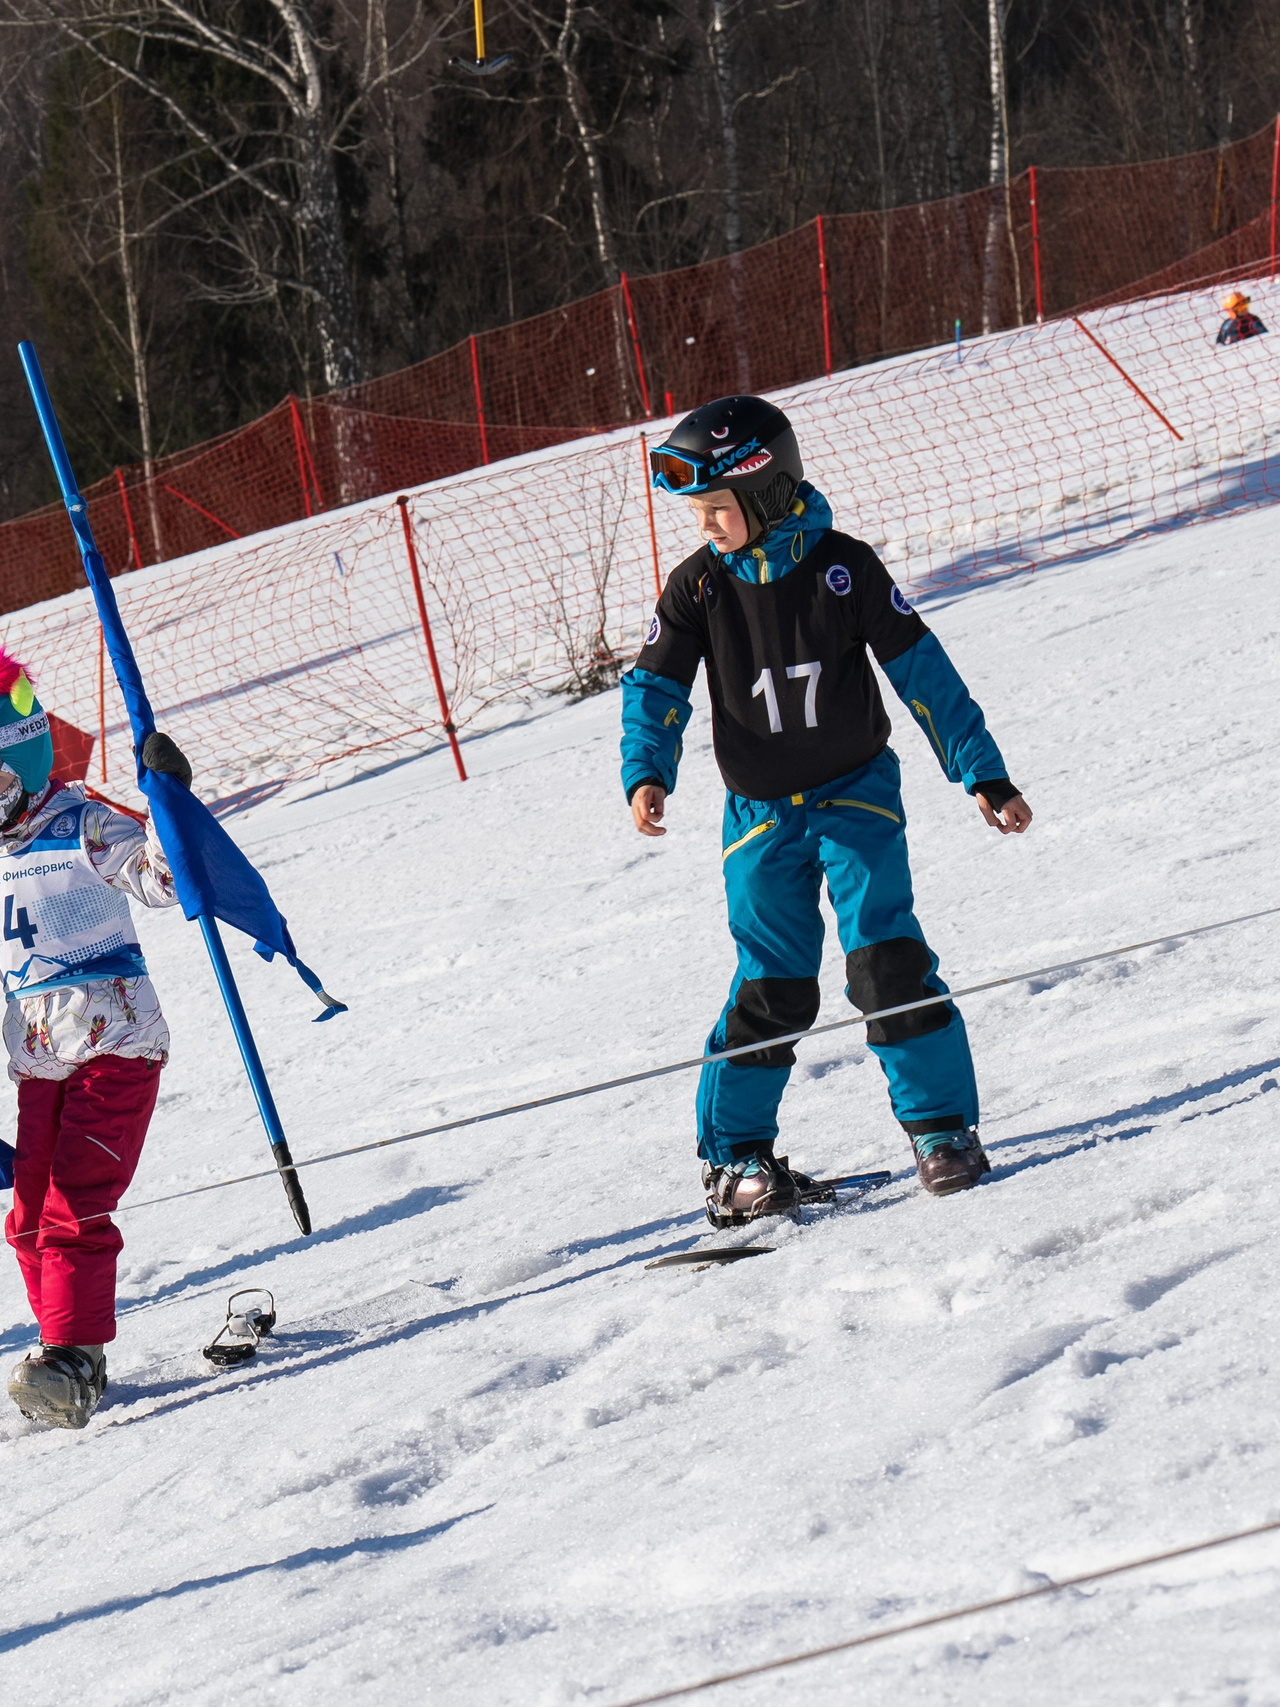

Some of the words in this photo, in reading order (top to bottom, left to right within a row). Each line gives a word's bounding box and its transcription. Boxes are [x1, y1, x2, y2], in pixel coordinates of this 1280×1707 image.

[709, 436, 761, 476] uvex
[751, 660, 822, 734] 17
[2, 860, 74, 882] Финсервис
[3, 893, 39, 950] 4
